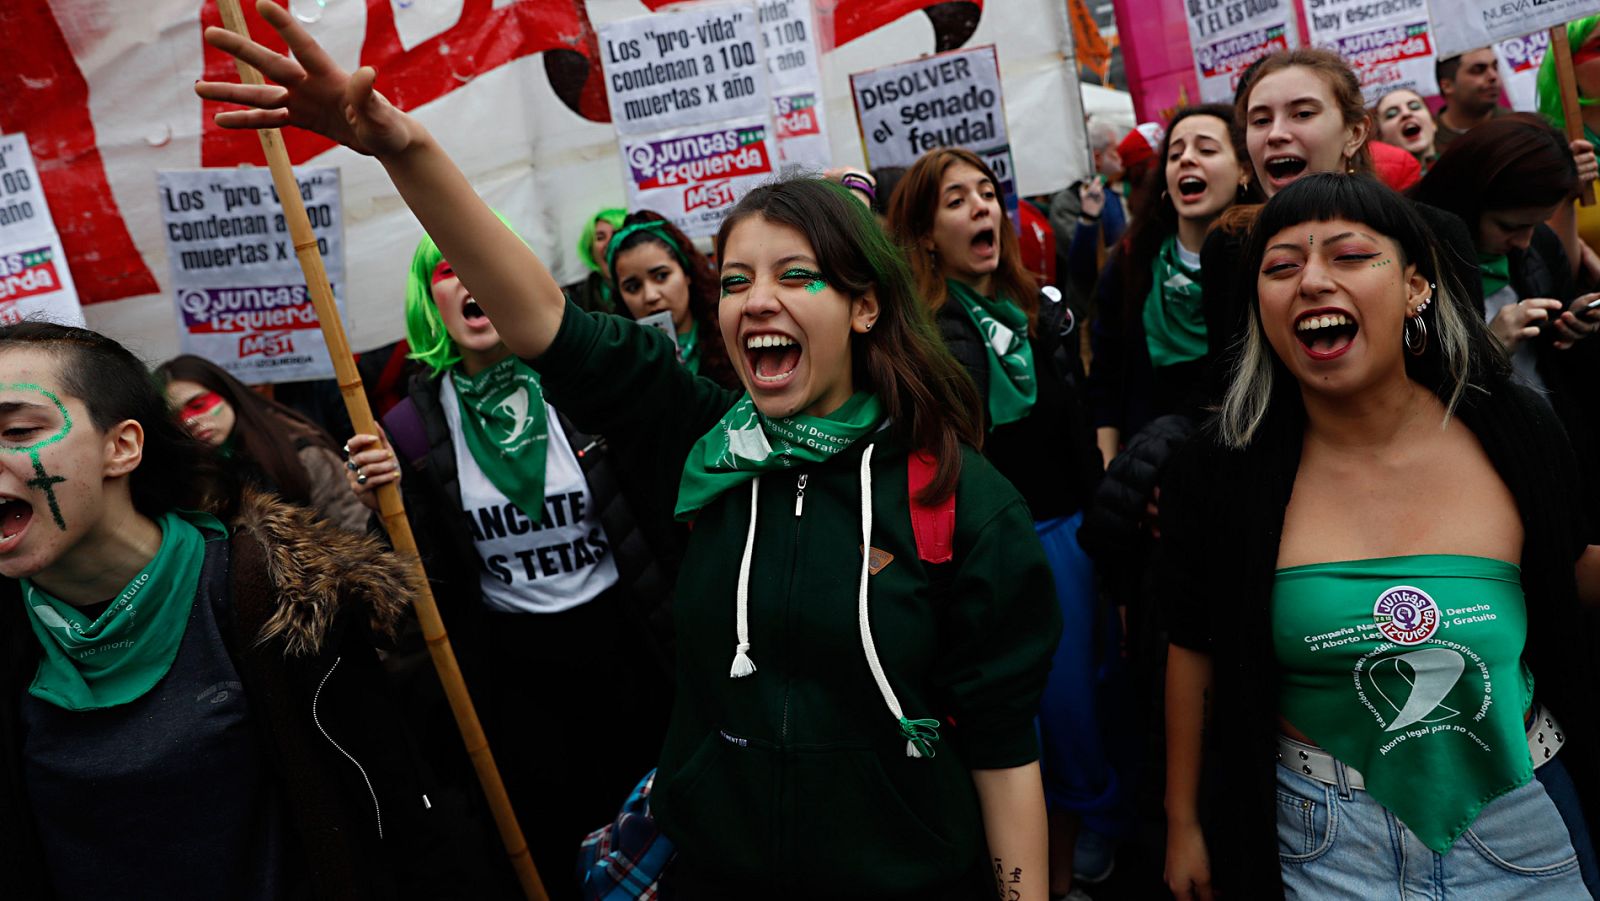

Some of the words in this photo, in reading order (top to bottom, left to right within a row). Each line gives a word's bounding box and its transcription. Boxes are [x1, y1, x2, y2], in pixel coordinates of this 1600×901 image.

[607, 39, 641, 64] Los
[644, 13, 742, 58] "pro-vida"
[775, 20, 806, 46] 100
[1208, 12, 1223, 33] EL
[1312, 13, 1340, 31] hay
[611, 58, 699, 93] condenan
[703, 54, 715, 74] a
[719, 41, 756, 70] 100
[777, 47, 806, 71] año
[623, 87, 702, 121] muertas
[722, 72, 756, 100] año
[859, 57, 971, 111] DISOLVER
[873, 120, 893, 144] el
[900, 85, 995, 125] senado
[907, 112, 995, 154] feudal
[0, 168, 32, 197] 00
[655, 148, 763, 186] izquierda
[165, 187, 205, 213] Los
[684, 180, 735, 213] MST
[168, 214, 268, 242] condenan
[275, 215, 287, 234] a
[180, 243, 268, 271] muertas
[240, 333, 294, 358] MST
[795, 422, 808, 433] el
[797, 435, 804, 444] y
[806, 438, 845, 454] Gratu
[464, 491, 587, 542] ANCATE
[487, 553, 513, 586] S
[515, 527, 609, 582] TETAS
[106, 572, 150, 619] Gratuito
[1304, 626, 1354, 643] Campaña
[1446, 603, 1490, 616] Derecho
[1310, 643, 1320, 653] al
[1322, 634, 1361, 651] Aborto
[1362, 630, 1383, 642] Leg
[1443, 619, 1451, 629] y
[1450, 614, 1496, 626] Gratuito
[1384, 609, 1434, 642] izquierda
[100, 639, 135, 652] morir
[1426, 638, 1481, 663] onceptivos
[1476, 660, 1490, 680] para
[1484, 680, 1492, 693] no
[1379, 733, 1406, 756] Aborto
[1406, 725, 1430, 739] legal
[1431, 724, 1451, 735] para
[1453, 724, 1466, 734] no
[1467, 730, 1492, 752] morir
